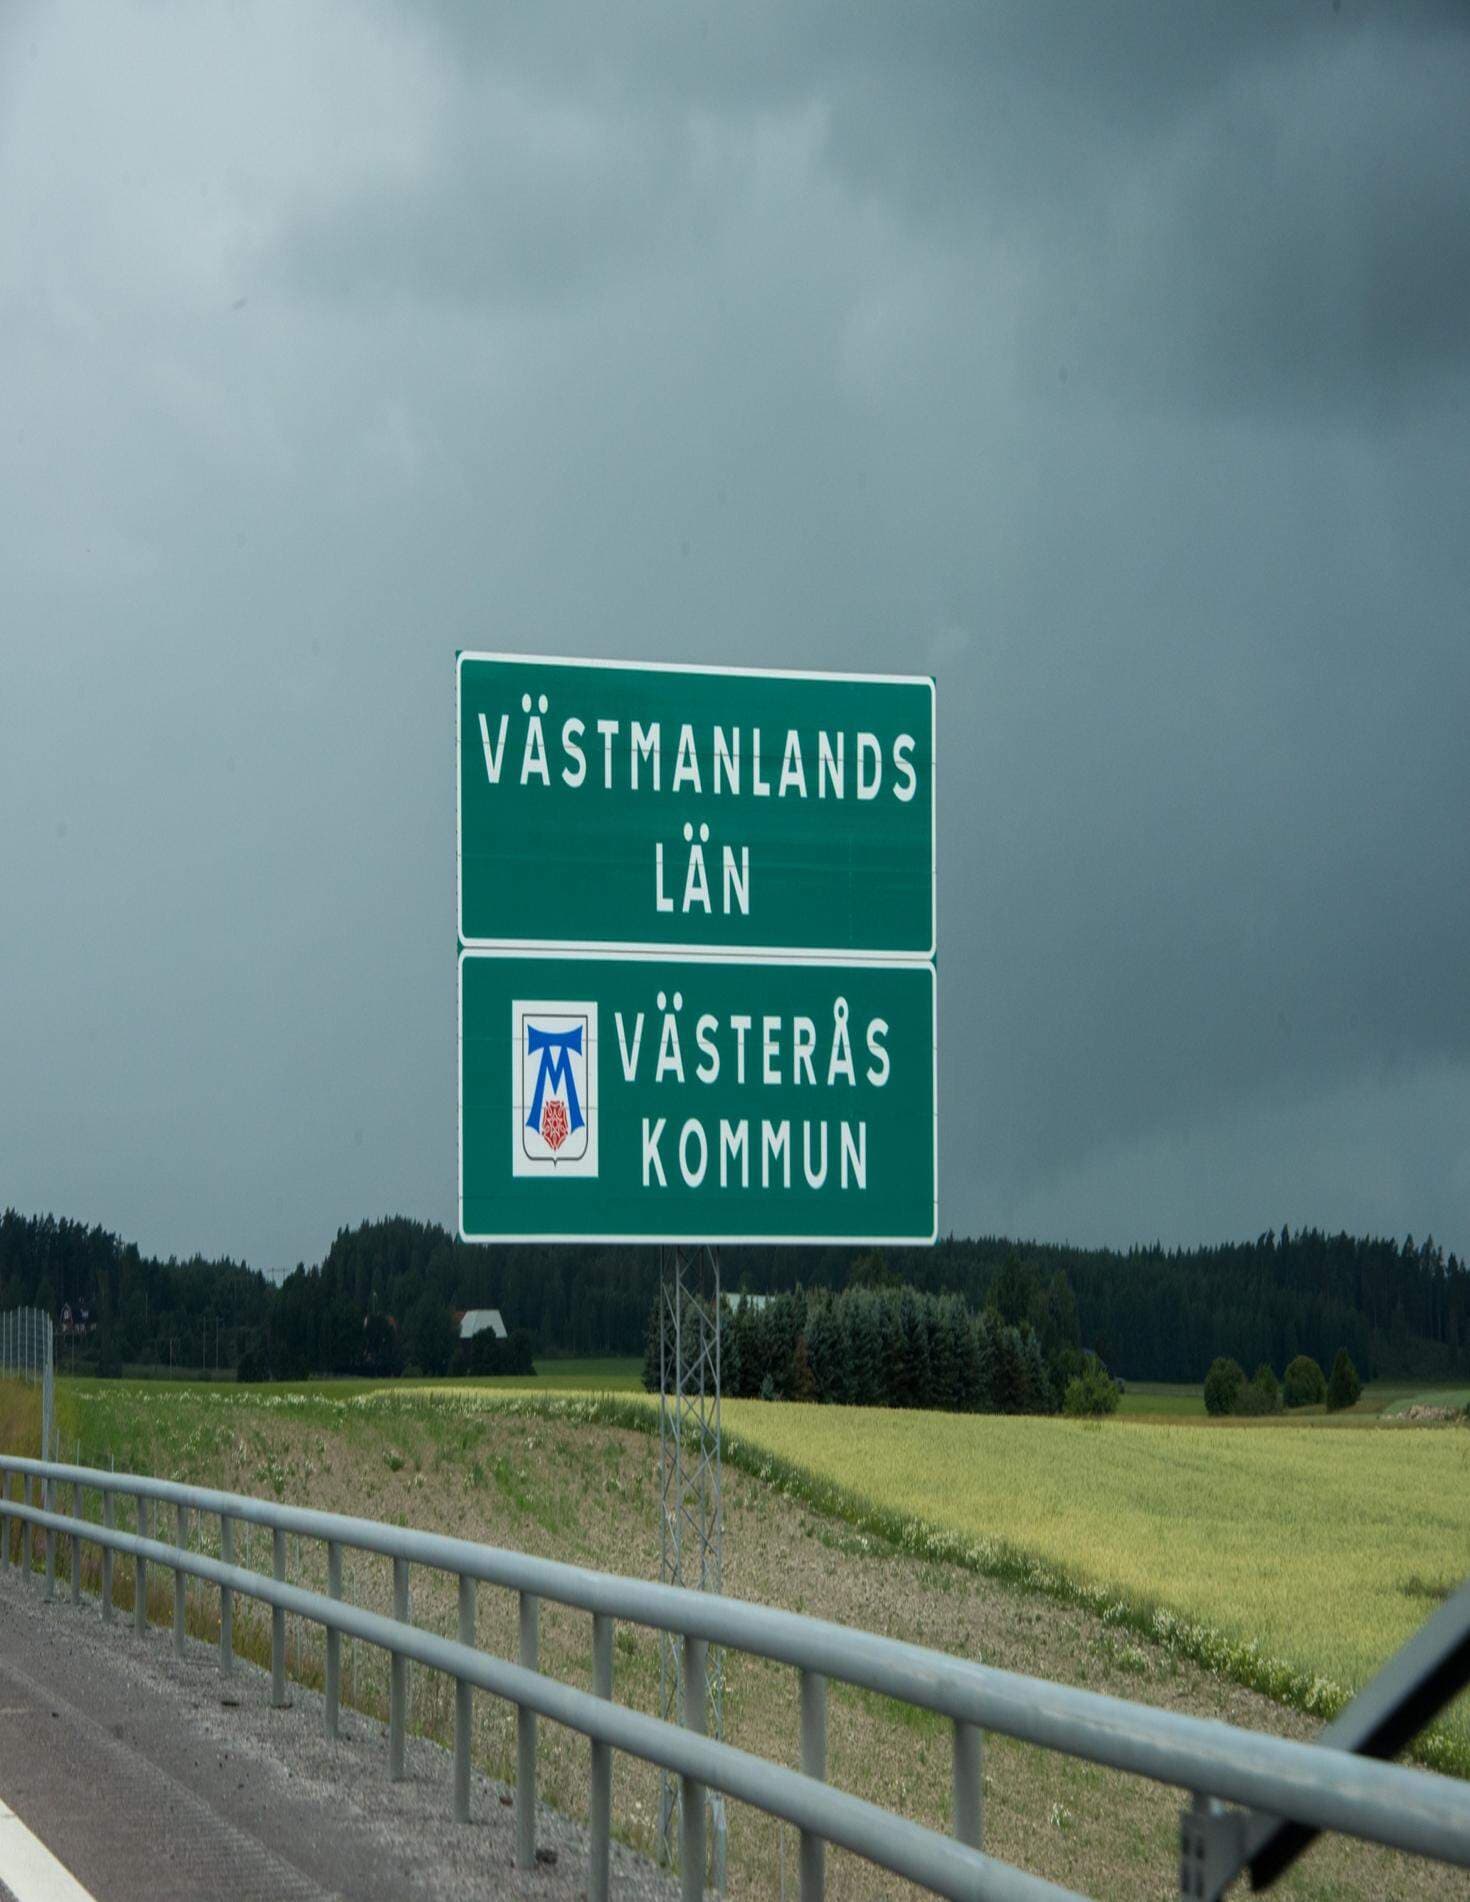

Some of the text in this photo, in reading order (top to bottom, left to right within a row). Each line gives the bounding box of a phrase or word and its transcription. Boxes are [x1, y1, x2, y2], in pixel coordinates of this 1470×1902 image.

[478, 693, 917, 802] VÄSTMANLANDS
[655, 822, 750, 915] LÄN
[614, 991, 891, 1087] VÄSTERÅS
[642, 1118, 868, 1189] KOMMUN
